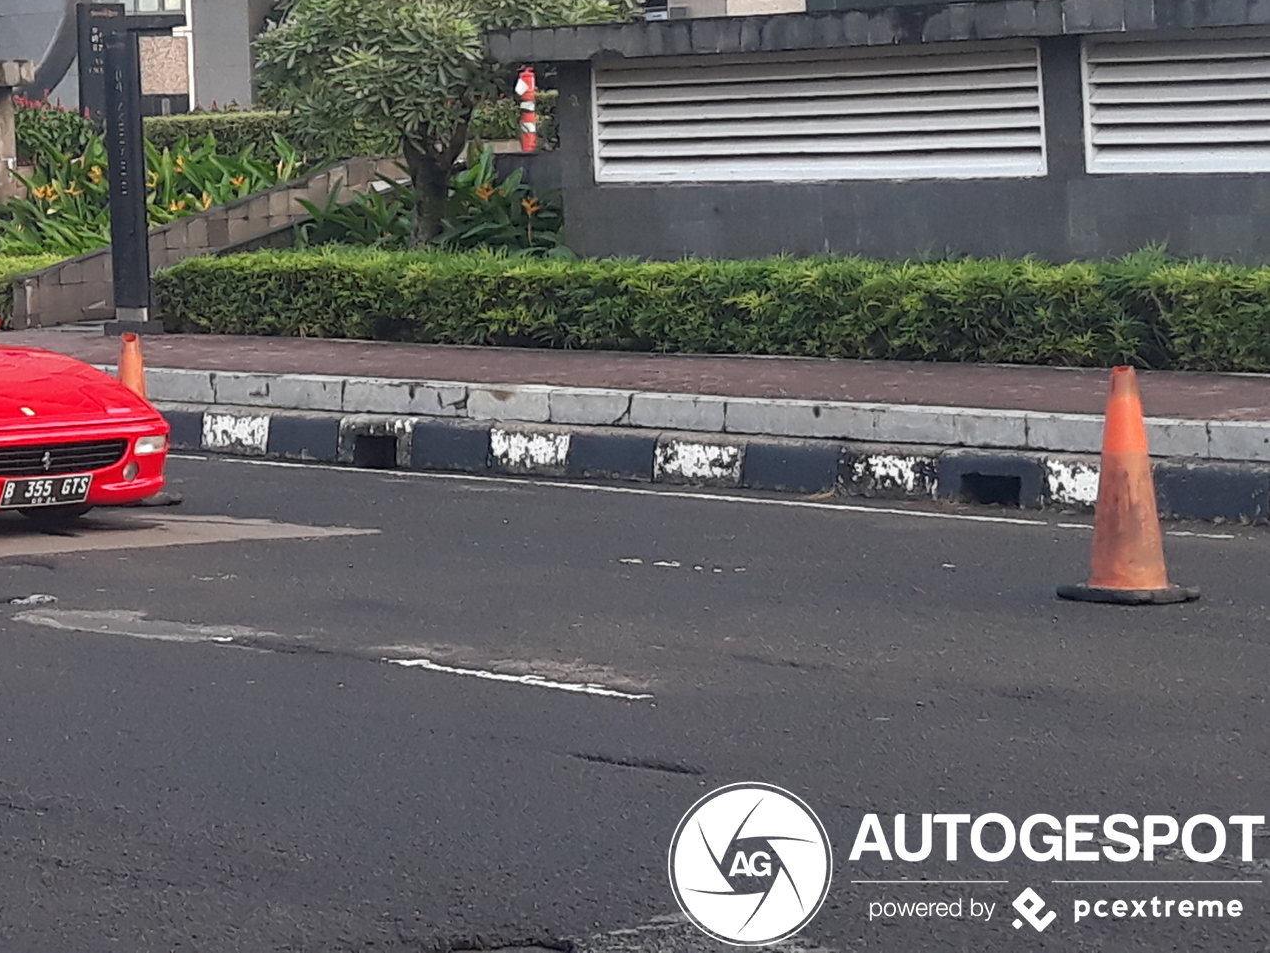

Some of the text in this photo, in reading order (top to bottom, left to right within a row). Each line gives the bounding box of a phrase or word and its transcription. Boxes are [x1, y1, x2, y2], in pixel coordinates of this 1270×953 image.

[4, 477, 89, 499] B 355 GTS
